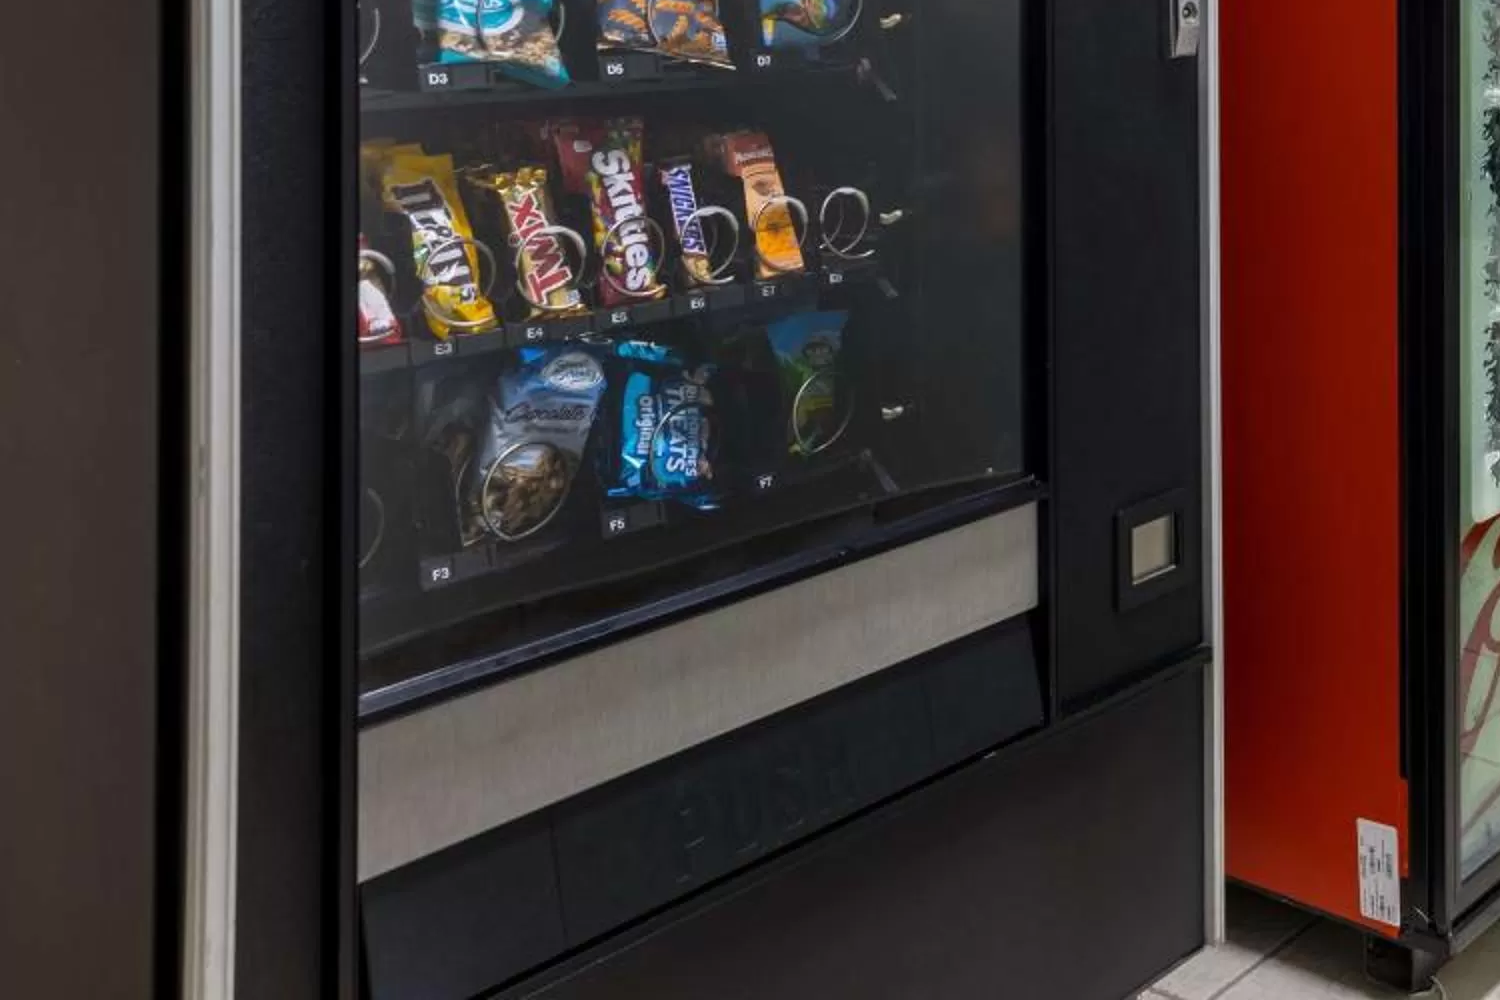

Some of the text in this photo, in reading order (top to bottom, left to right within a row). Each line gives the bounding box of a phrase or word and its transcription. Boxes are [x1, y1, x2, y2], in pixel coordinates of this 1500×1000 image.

[428, 72, 448, 86] D3
[526, 326, 544, 340] E4
[432, 567, 450, 582] F3
